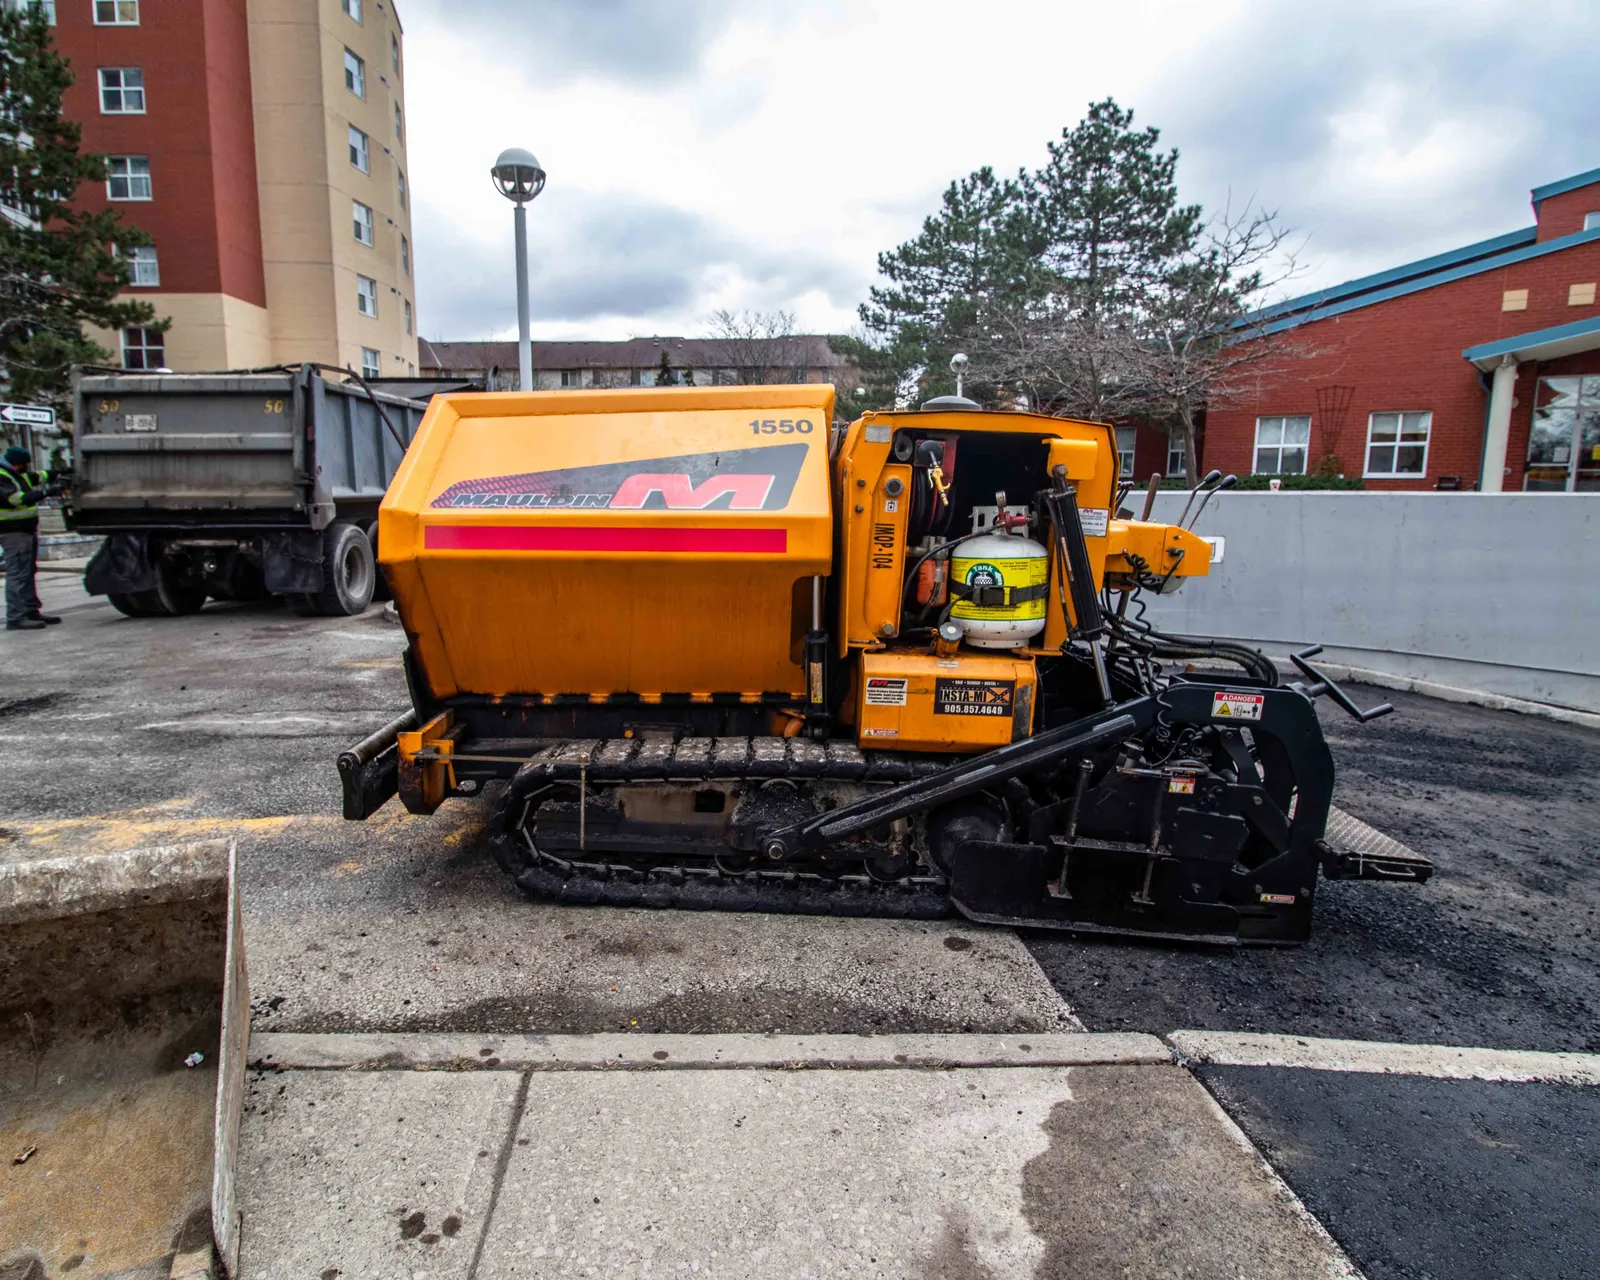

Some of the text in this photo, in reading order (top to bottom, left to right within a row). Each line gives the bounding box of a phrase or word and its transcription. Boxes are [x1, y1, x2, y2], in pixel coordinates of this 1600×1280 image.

[99, 400, 119, 413] 50
[264, 400, 283, 414] 50
[749, 419, 814, 435] 1550
[450, 493, 612, 508] MAULDIN
[973, 565, 993, 573] Tank
[1228, 695, 1257, 703] DANGER
[944, 704, 1003, 715] 905.857.4649
